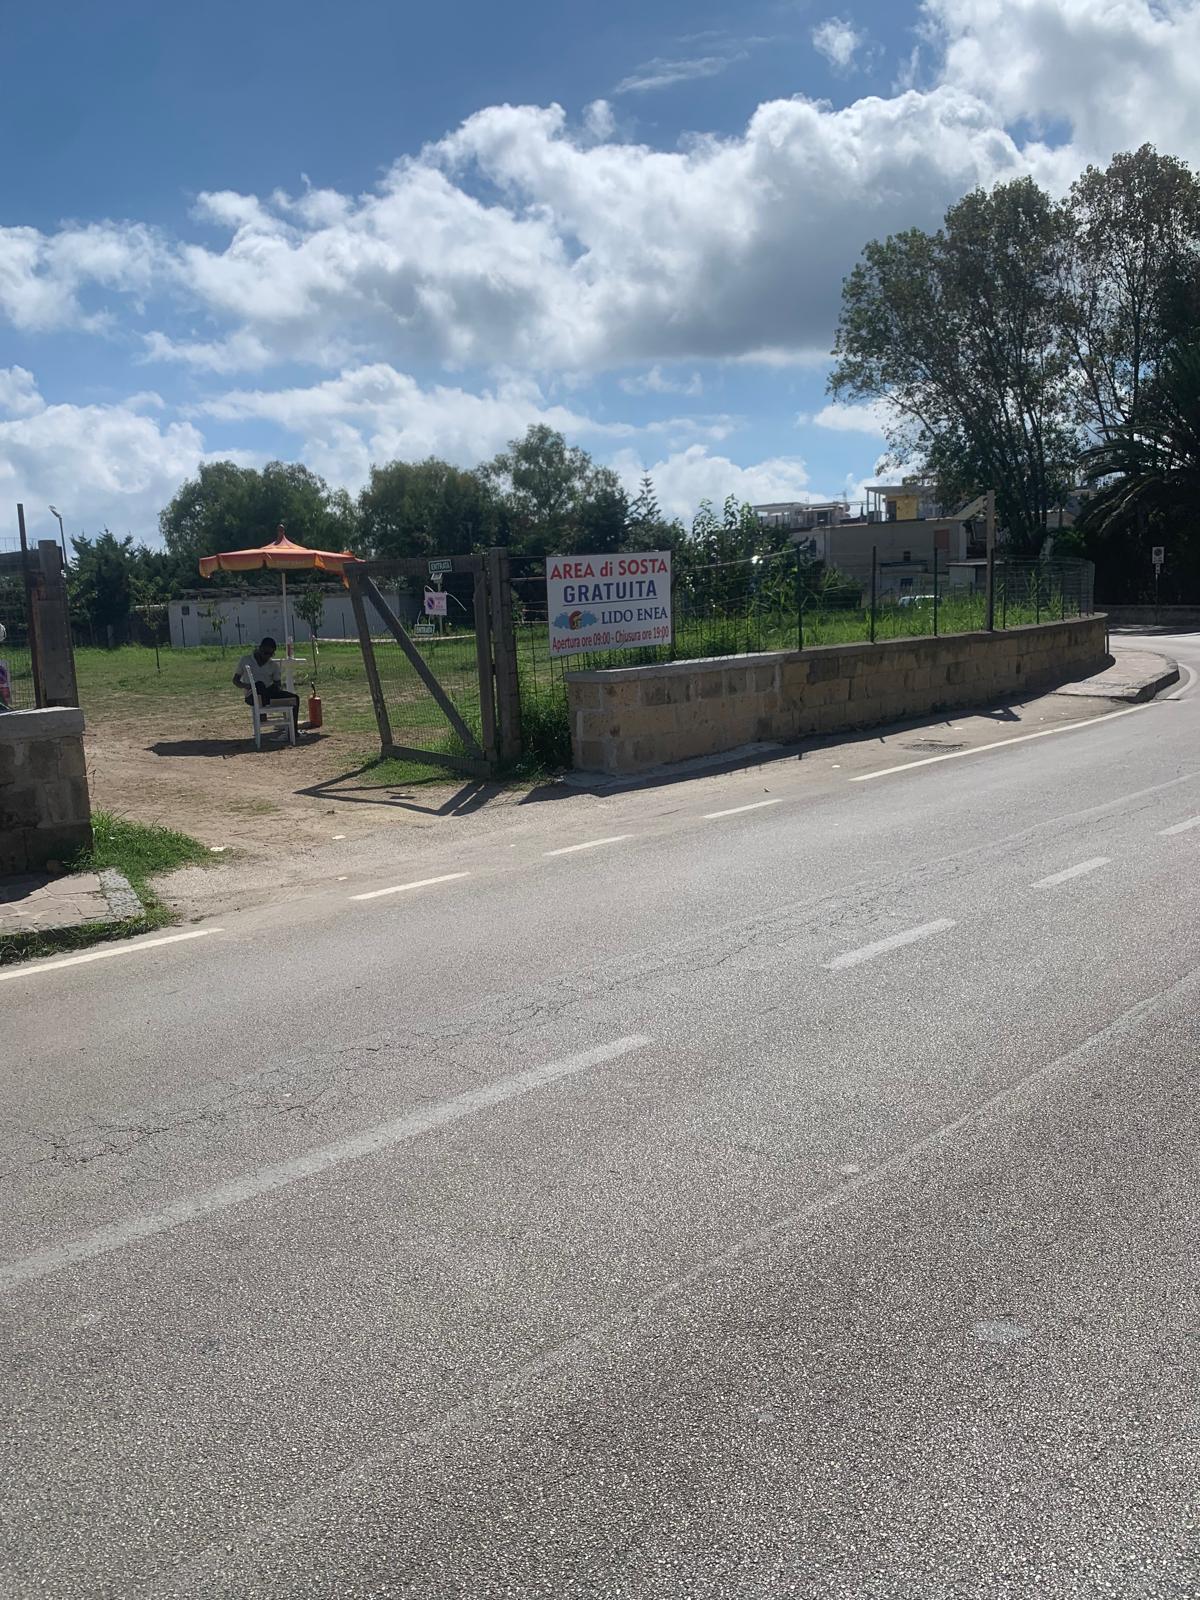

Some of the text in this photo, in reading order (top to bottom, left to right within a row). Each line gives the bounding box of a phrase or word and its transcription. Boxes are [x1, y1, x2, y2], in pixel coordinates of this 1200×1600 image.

[550, 558, 668, 580] AREA di SOSTA
[563, 580, 657, 603] GRATUITA
[602, 607, 668, 624] LIDO ENEA
[552, 636, 580, 653] Apertura
[581, 637, 593, 648] ore
[593, 631, 611, 647] 09:00
[616, 629, 641, 644] Chiusura
[642, 630, 652, 641] ore
[653, 626, 670, 640] 19:00
